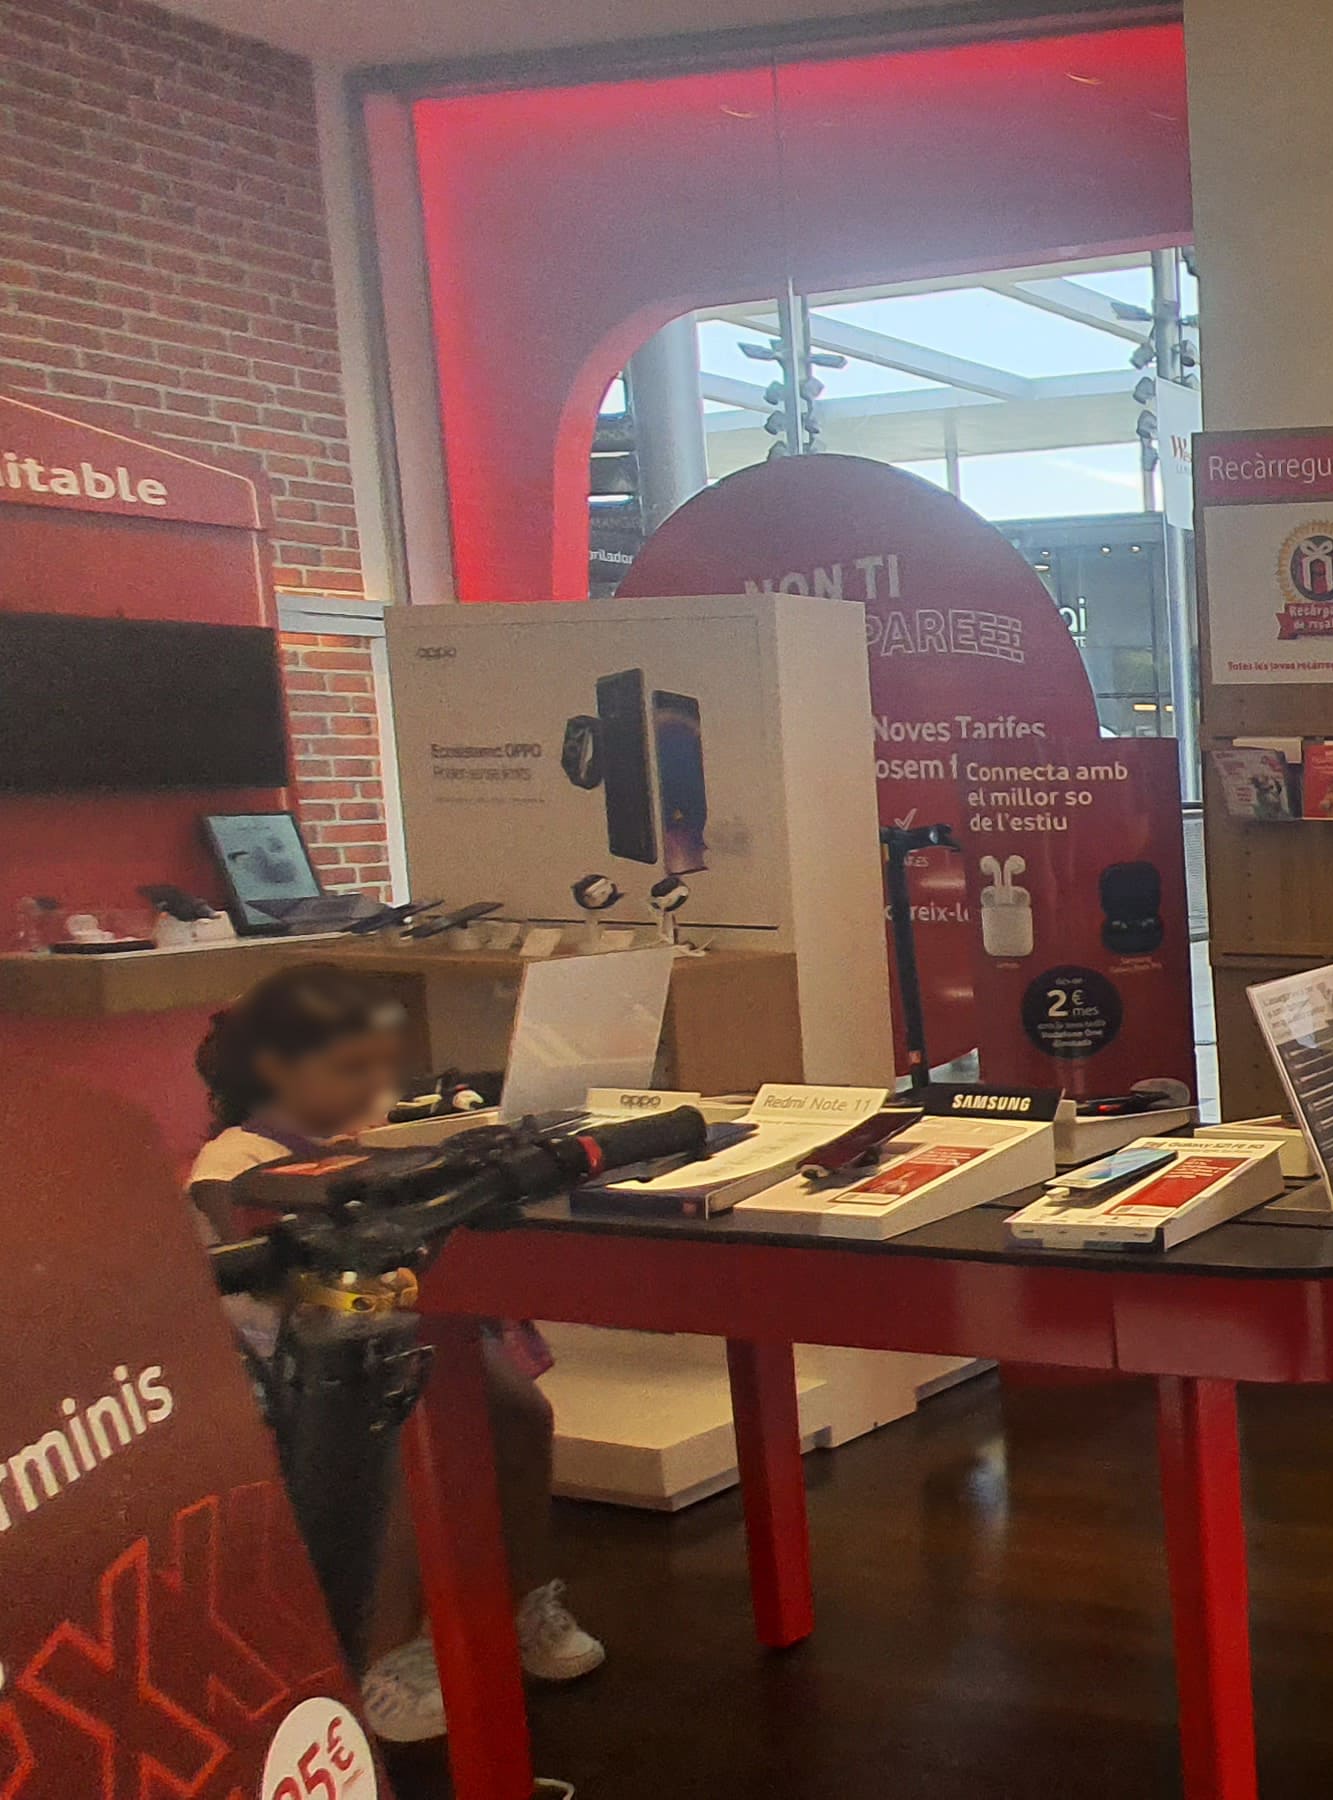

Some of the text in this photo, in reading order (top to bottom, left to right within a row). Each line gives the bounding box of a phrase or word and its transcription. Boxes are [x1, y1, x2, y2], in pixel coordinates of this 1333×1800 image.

[0, 450, 168, 506] itable
[744, 553, 901, 600] ON TI
[872, 715, 1047, 743] Noves Tarifes
[874, 757, 945, 780] osem
[966, 762, 1070, 782] Connecta
[1075, 760, 1129, 782] amb
[967, 787, 1094, 807] el millor so
[969, 812, 1069, 832] de l'estiu
[1046, 988, 1086, 1019] 2 €
[1071, 1007, 1100, 1018] mes
[619, 1094, 661, 1110] oppo
[762, 1094, 872, 1112] Redmi Note 11
[951, 1093, 1032, 1113] SAMSUNG
